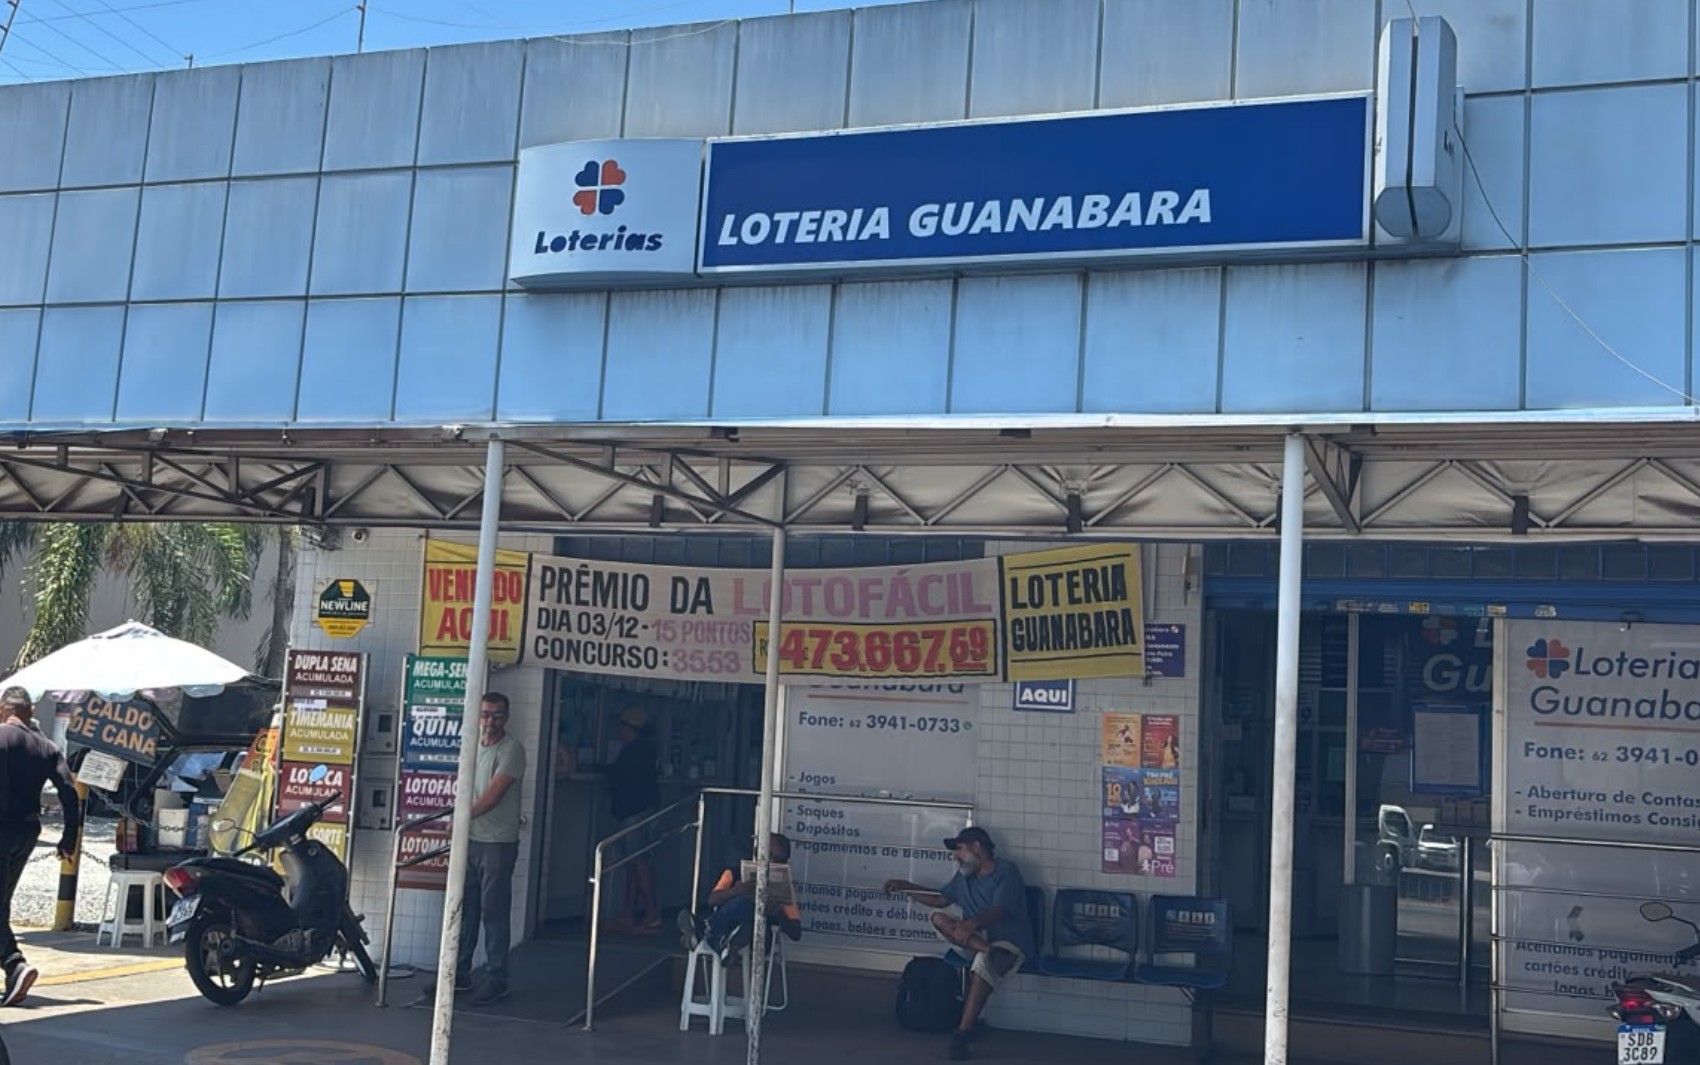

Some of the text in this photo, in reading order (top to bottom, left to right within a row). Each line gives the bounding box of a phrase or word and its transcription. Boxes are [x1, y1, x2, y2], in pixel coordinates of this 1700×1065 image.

[718, 188, 1212, 246] LOTERIA GUANABARA
[534, 226, 663, 255] Loterias
[540, 563, 992, 618] PRÊMIO DA LOTOFÁCIL
[1011, 563, 1128, 609] LOTERIA
[320, 600, 369, 612] NEWLINE
[537, 607, 572, 633] DIA
[682, 620, 750, 646] PONTOS
[1011, 608, 1137, 652] GUANABARA
[294, 654, 358, 673] DUPLA SENA
[534, 634, 742, 675] CONCURSO: 3553
[295, 672, 354, 684] ACUMULADA
[1021, 688, 1068, 704] AQUI
[87, 696, 153, 731] CALDO
[290, 711, 353, 729] TIMEMANIA
[798, 711, 844, 728] Fone:
[866, 714, 960, 733] 3941-0733
[102, 724, 156, 759] CANA
[289, 728, 349, 740] ACUMULADA
[1524, 741, 1585, 760] Fone:
[1592, 751, 1608, 762] 62
[798, 771, 836, 785] Jogos
[1527, 785, 1607, 803] Abertura
[1613, 790, 1636, 804] de
[796, 804, 844, 820] Saques
[1527, 804, 1642, 825] Empréstimos
[796, 821, 860, 838] Depósitos
[833, 902, 873, 916] crédito
[1524, 960, 1580, 976] cartões
[1628, 1031, 1654, 1047] SDB
[1623, 1046, 1658, 1062] 3C89
